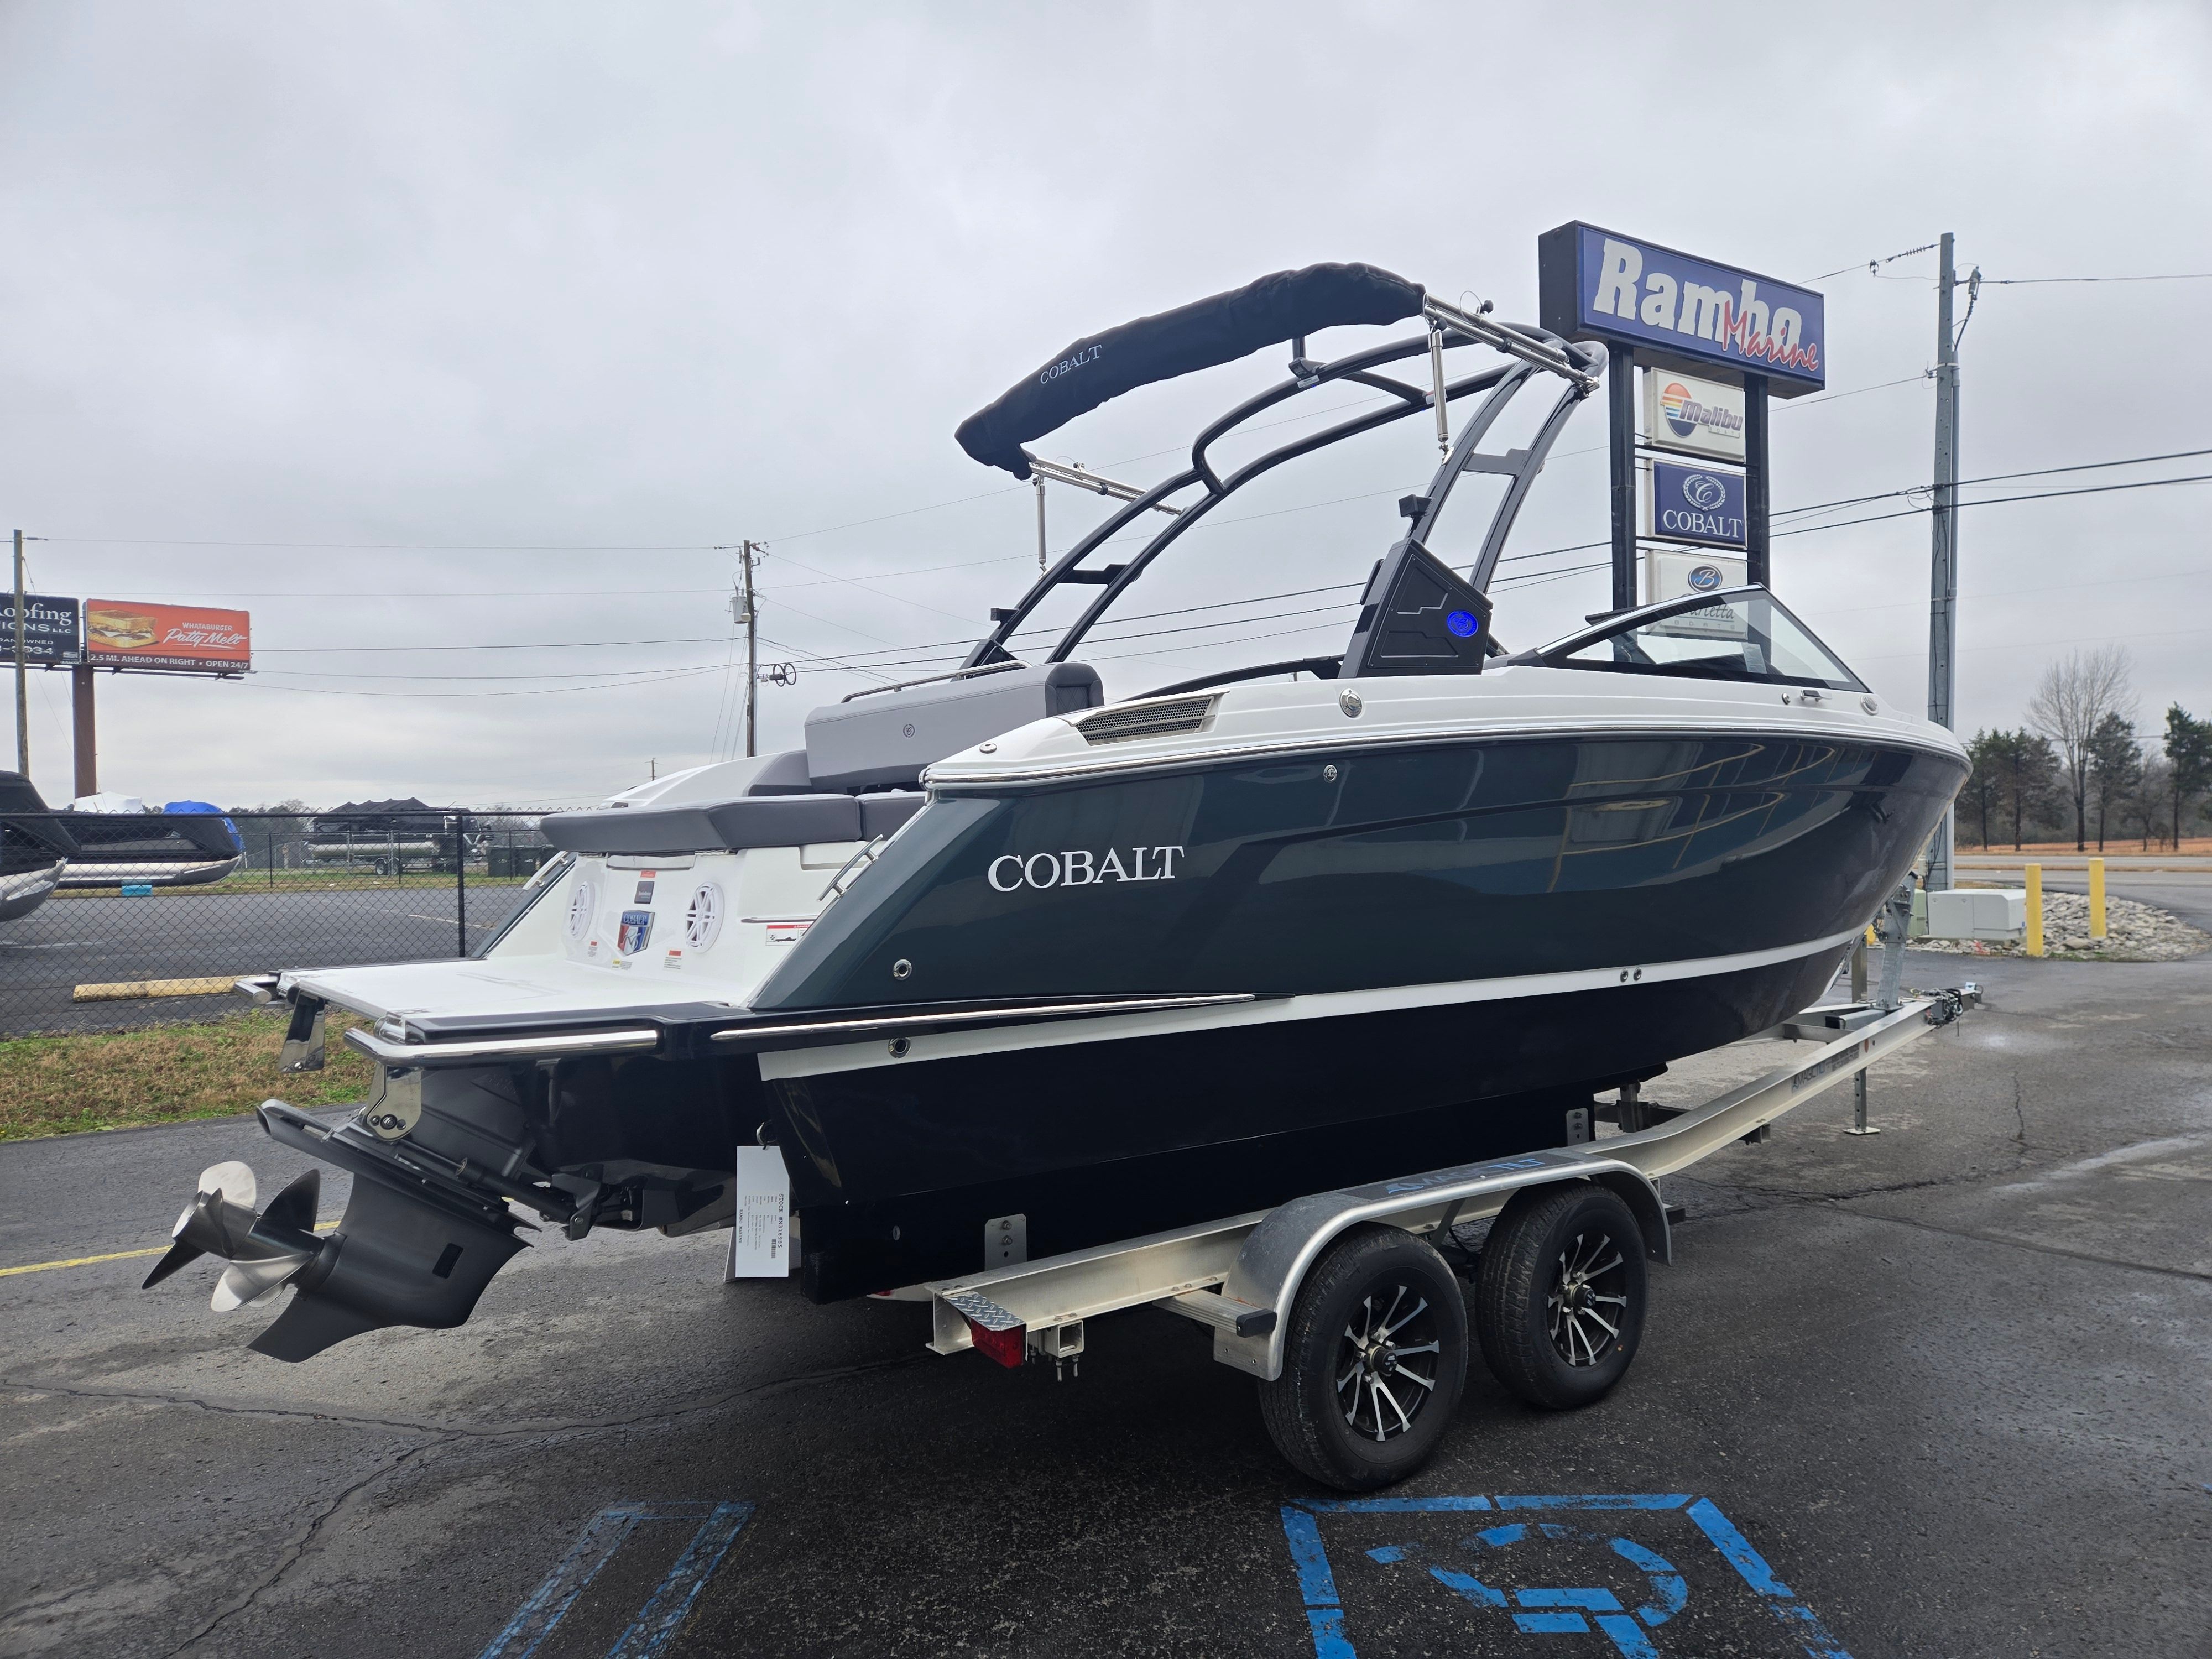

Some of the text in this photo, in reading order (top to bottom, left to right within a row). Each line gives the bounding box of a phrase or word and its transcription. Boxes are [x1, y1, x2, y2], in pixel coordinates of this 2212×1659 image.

[1593, 237, 1802, 351] Rambo
[1723, 300, 1819, 371] Marine
[1040, 345, 1102, 384] COBALT
[1679, 400, 1743, 431] Malibu
[1663, 509, 1743, 538] COBALT
[0, 603, 71, 626] ofing
[0, 622, 50, 632] IONS
[182, 622, 233, 631] WHATABURGER
[163, 628, 248, 648] Patty Melt
[988, 846, 1185, 892] COBALT
[623, 914, 646, 925] COBALT
